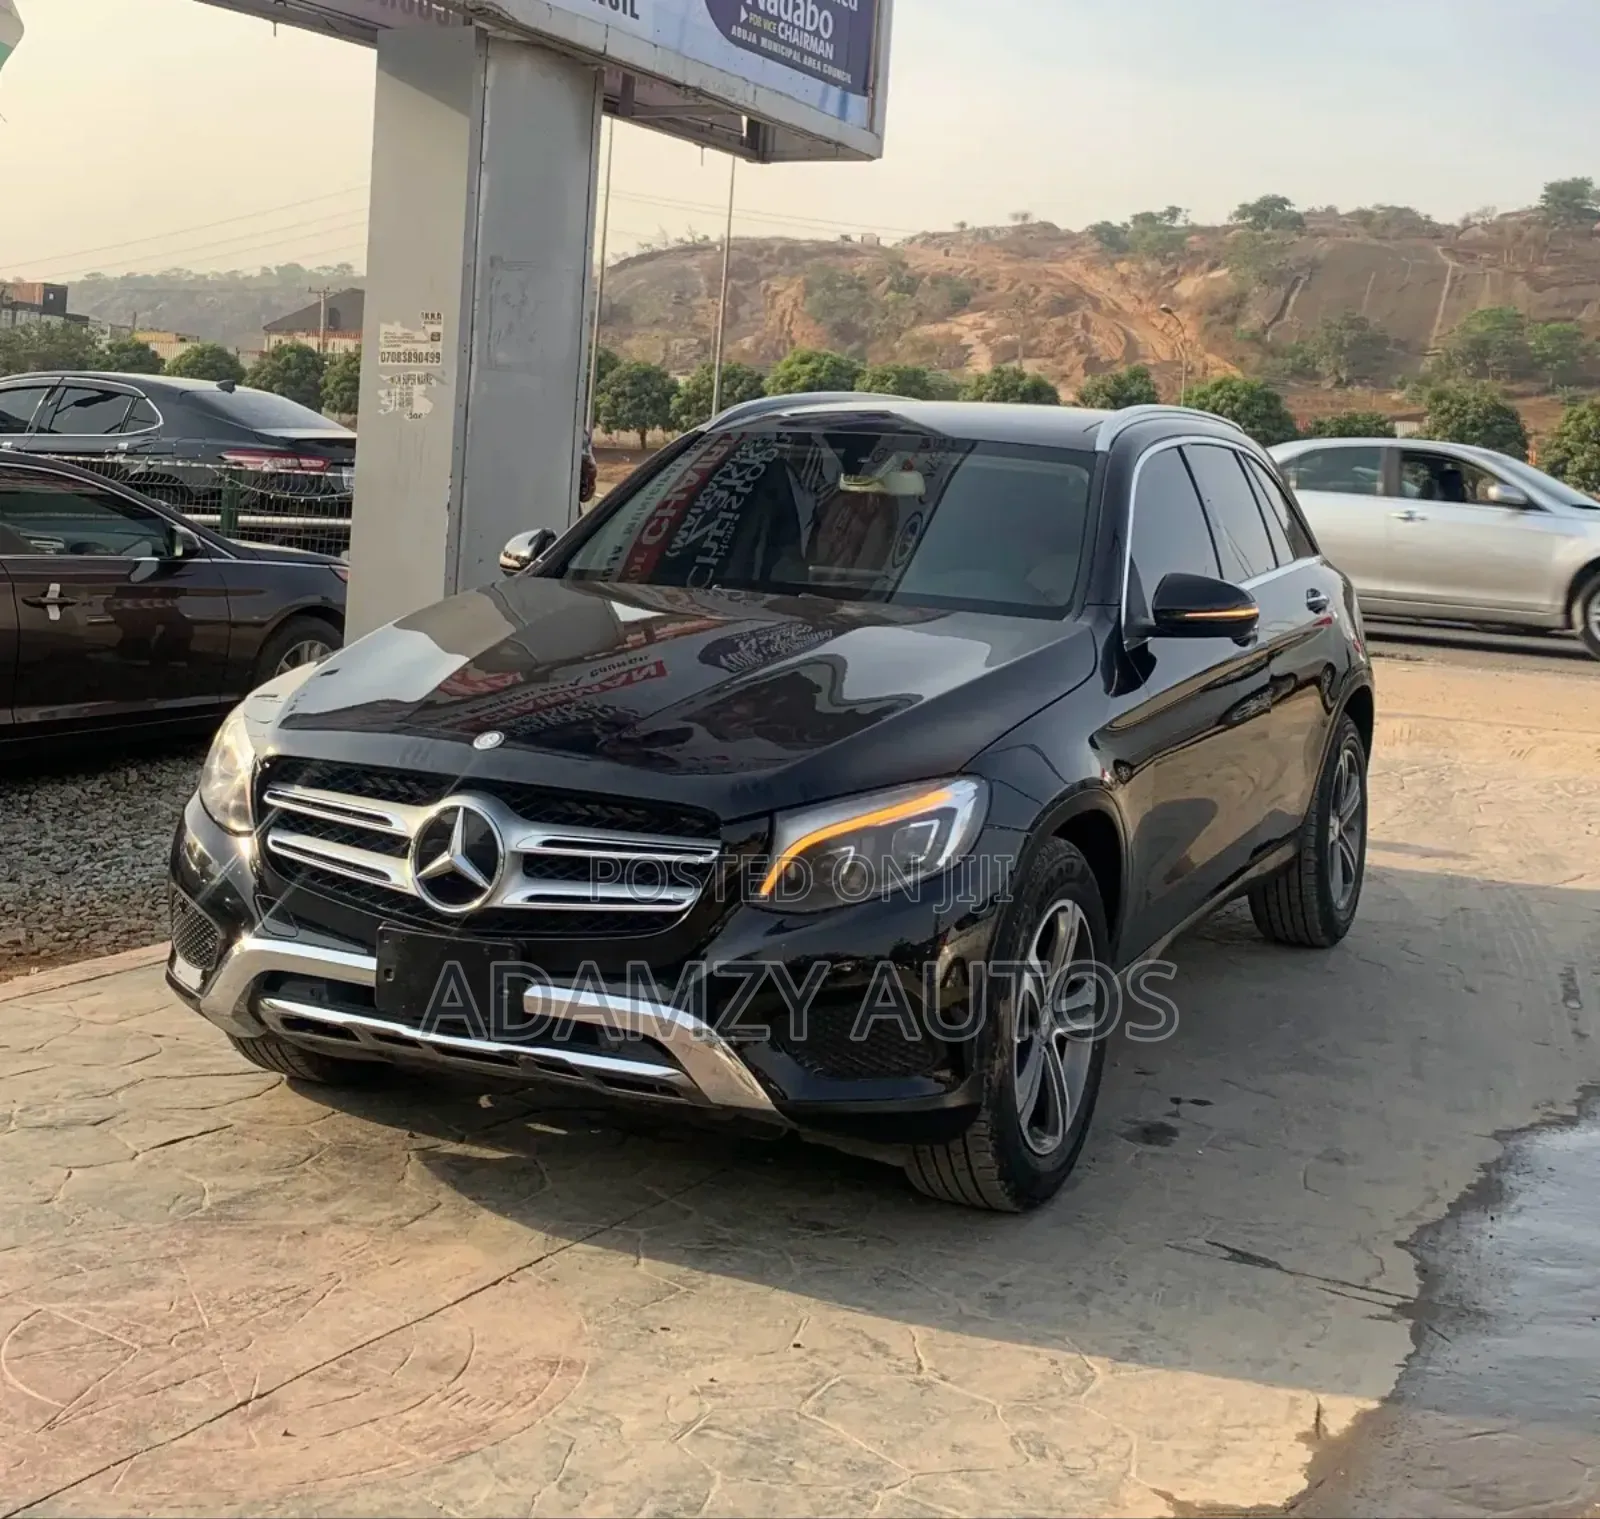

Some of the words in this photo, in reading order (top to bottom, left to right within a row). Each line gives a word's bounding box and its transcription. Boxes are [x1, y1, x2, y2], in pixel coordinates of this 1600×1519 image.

[731, 24, 757, 44] ABUJA
[760, 37, 801, 63] MUNICIPAL
[803, 55, 821, 71] AREA
[822, 63, 852, 84] COUNCIL
[763, 18, 777, 34] VICE
[778, 21, 834, 60] CHAIRMAN
